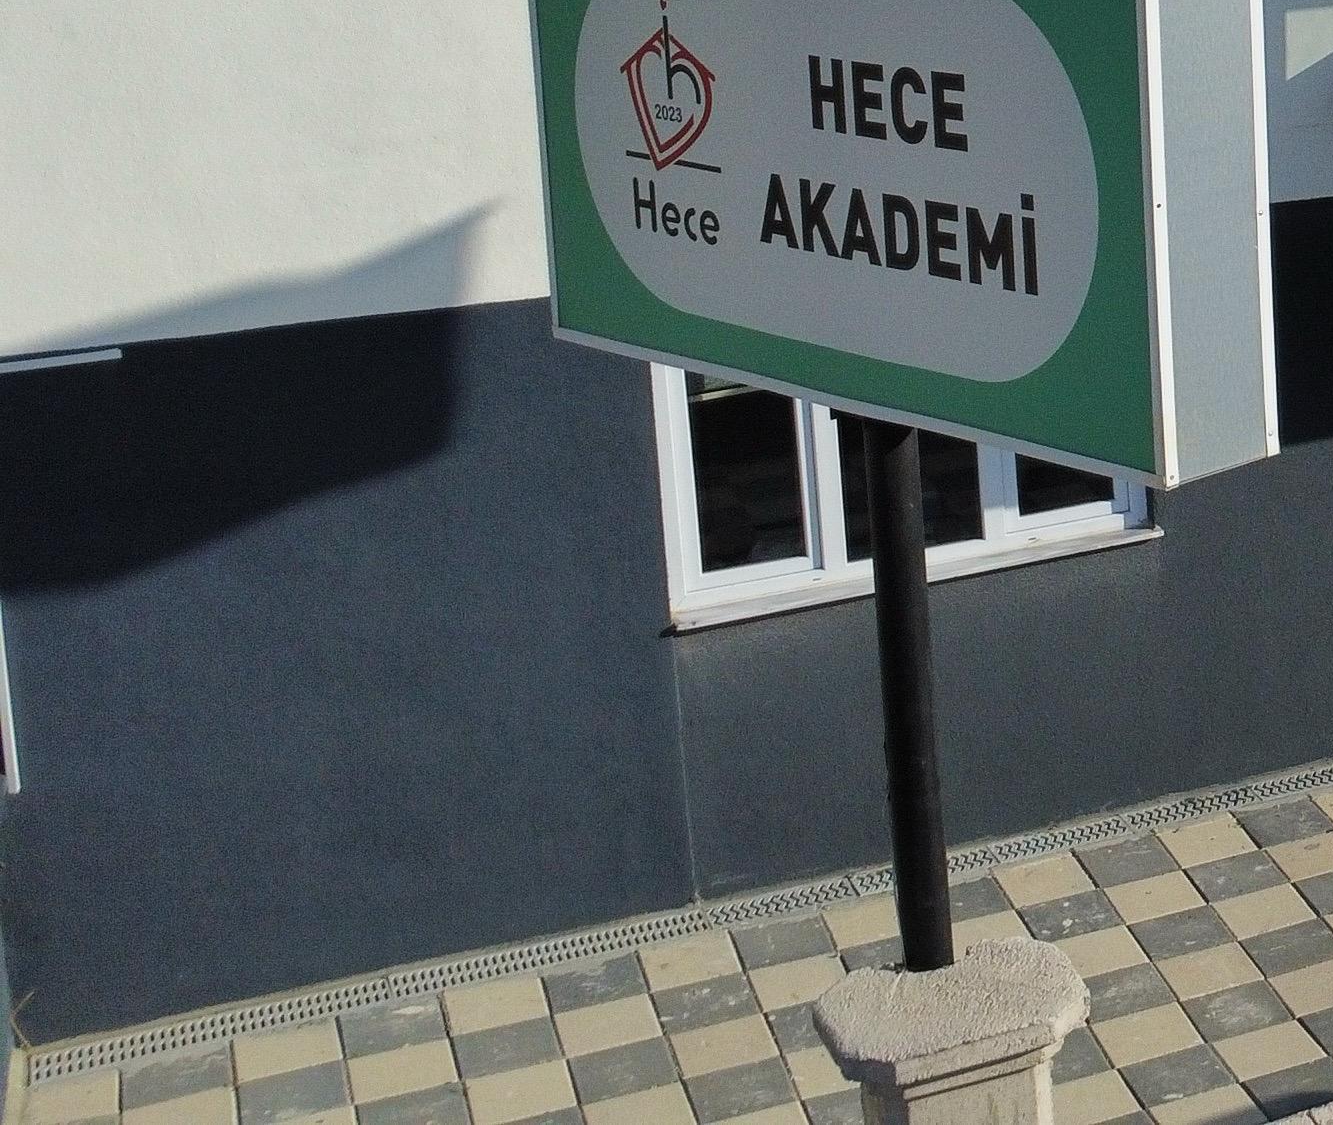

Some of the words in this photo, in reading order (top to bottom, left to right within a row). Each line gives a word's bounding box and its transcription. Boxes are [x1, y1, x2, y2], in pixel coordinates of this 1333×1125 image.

[654, 103, 683, 123] 2023
[808, 55, 968, 152] HECE
[633, 177, 720, 245] Hece
[760, 173, 1038, 295] AKADEMİ
